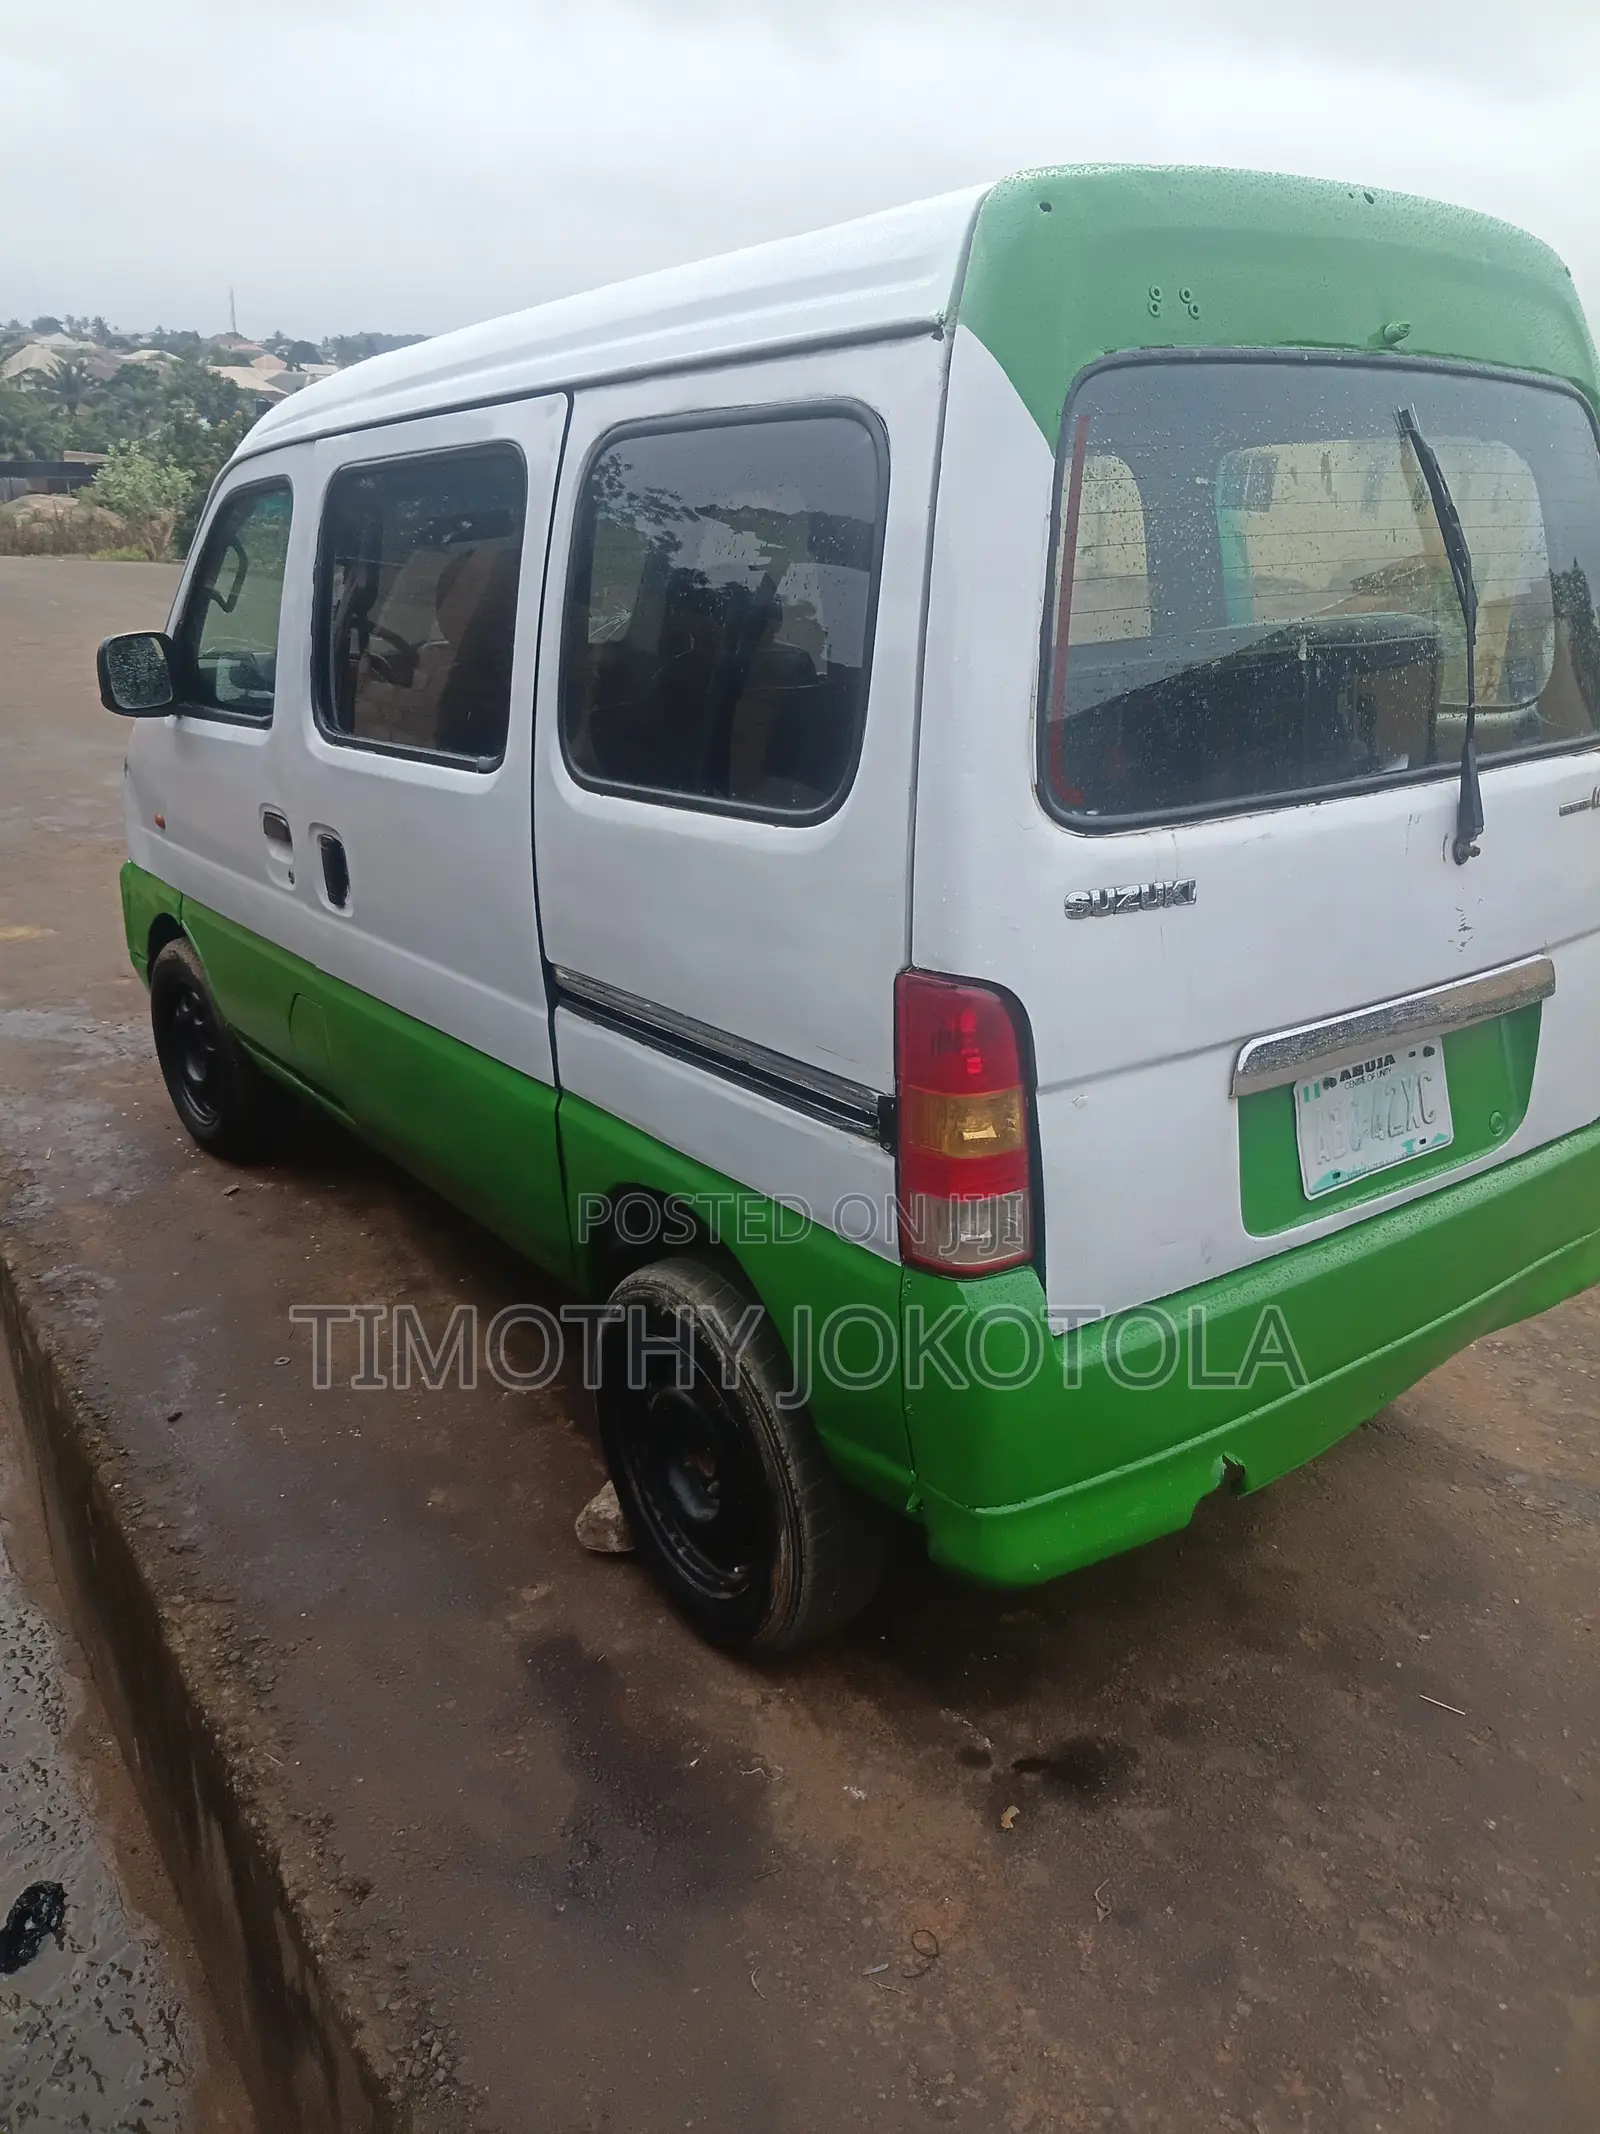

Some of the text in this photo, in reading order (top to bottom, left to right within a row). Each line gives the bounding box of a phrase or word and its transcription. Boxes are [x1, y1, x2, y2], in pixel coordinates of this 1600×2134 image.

[1063, 878, 1197, 919] SUZUKI
[1340, 1054, 1396, 1082] ABUJA
[1344, 1066, 1393, 1090] CENTRE OF UNITY
